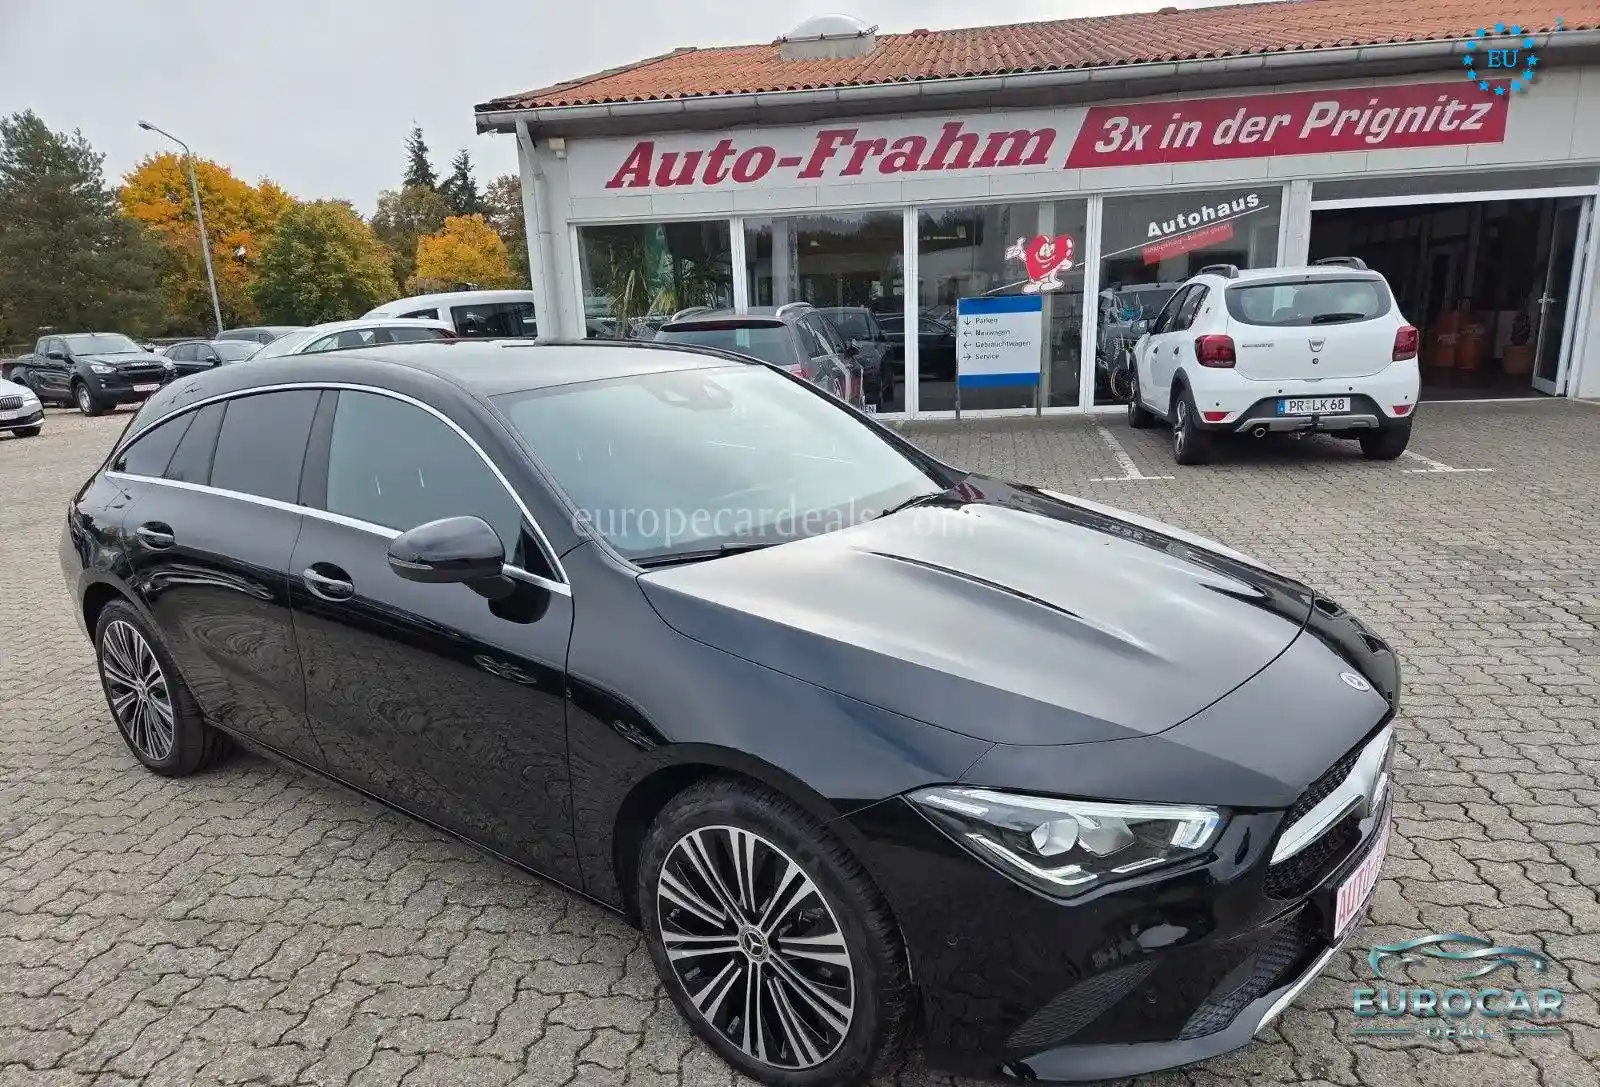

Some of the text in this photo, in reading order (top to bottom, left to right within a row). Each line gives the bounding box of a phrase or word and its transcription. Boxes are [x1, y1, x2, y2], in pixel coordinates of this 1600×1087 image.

[1094, 94, 1493, 152] 3x in der Prignitz
[605, 121, 1056, 189] Auto-Frahm
[1147, 193, 1260, 237] Autohaus
[1289, 399, 1345, 411] PR LK 68
